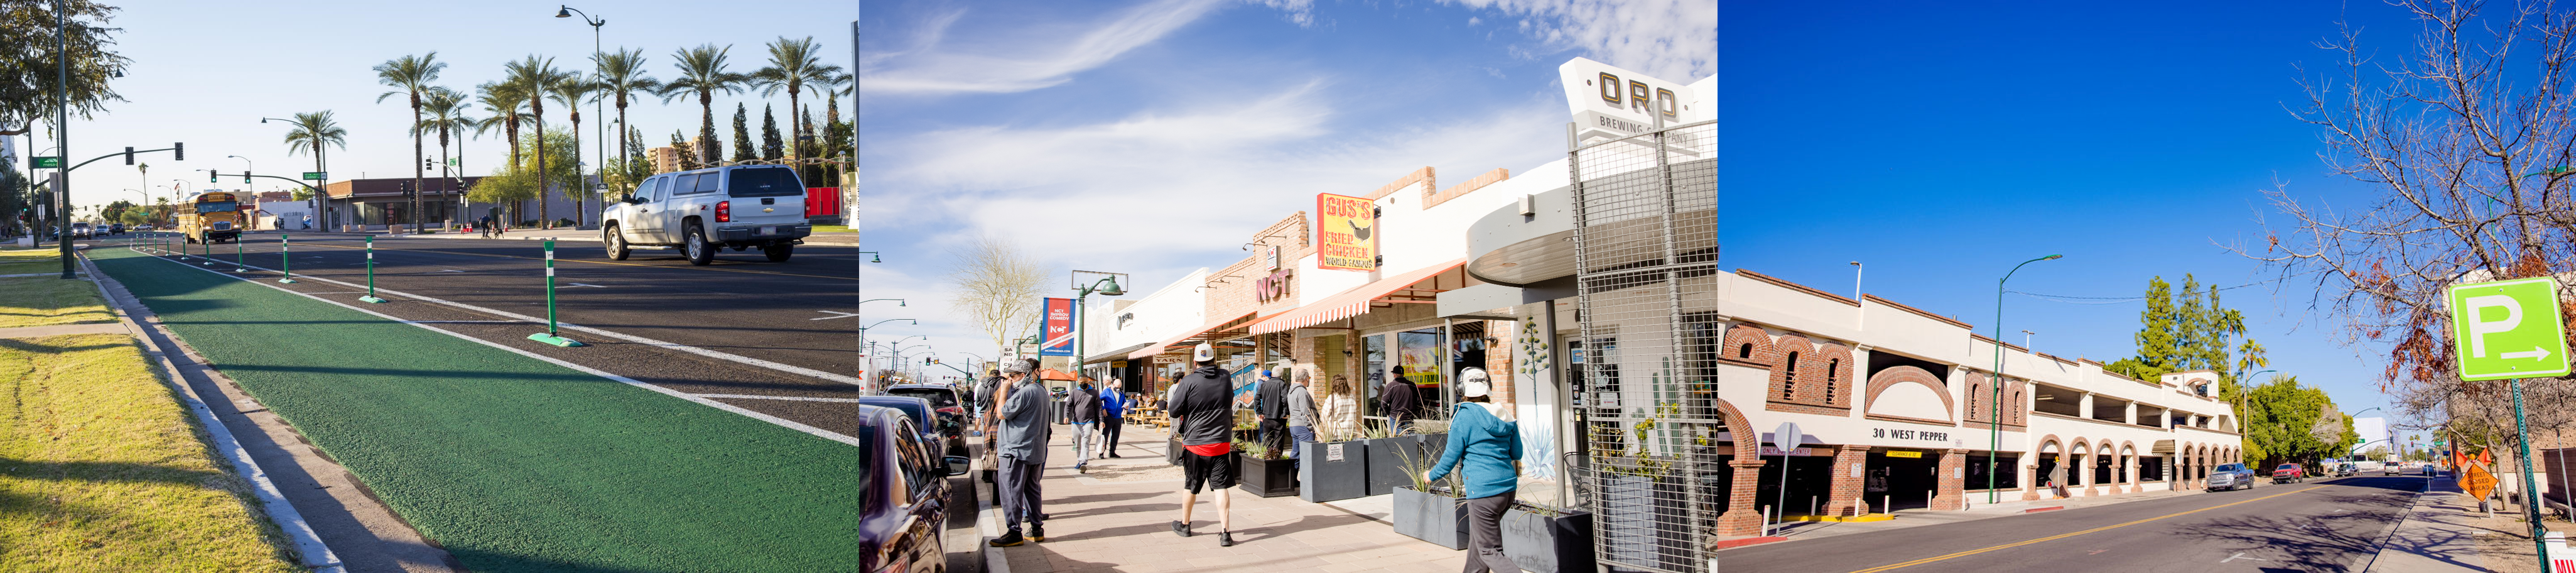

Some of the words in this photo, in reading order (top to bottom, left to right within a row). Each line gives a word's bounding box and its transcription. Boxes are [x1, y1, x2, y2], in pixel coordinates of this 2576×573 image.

[1599, 72, 1677, 118] ORO
[1600, 116, 1643, 133] BREWING
[1647, 127, 1687, 145] CPANY
[1326, 197, 1371, 220] GUS'S
[1325, 231, 1354, 244] FRIED
[1325, 244, 1368, 259] CHICKEN
[1325, 257, 1347, 265] WORLD
[1349, 259, 1373, 268] FAMOUS
[1256, 268, 1291, 302] NCT
[2465, 295, 2523, 358] P
[1405, 349, 1429, 365] GUS'S
[1404, 375, 1423, 383] WORLD
[1873, 428, 1885, 439] 30
[1891, 429, 1915, 440] WEST
[1920, 431, 1947, 441] PEPPER
